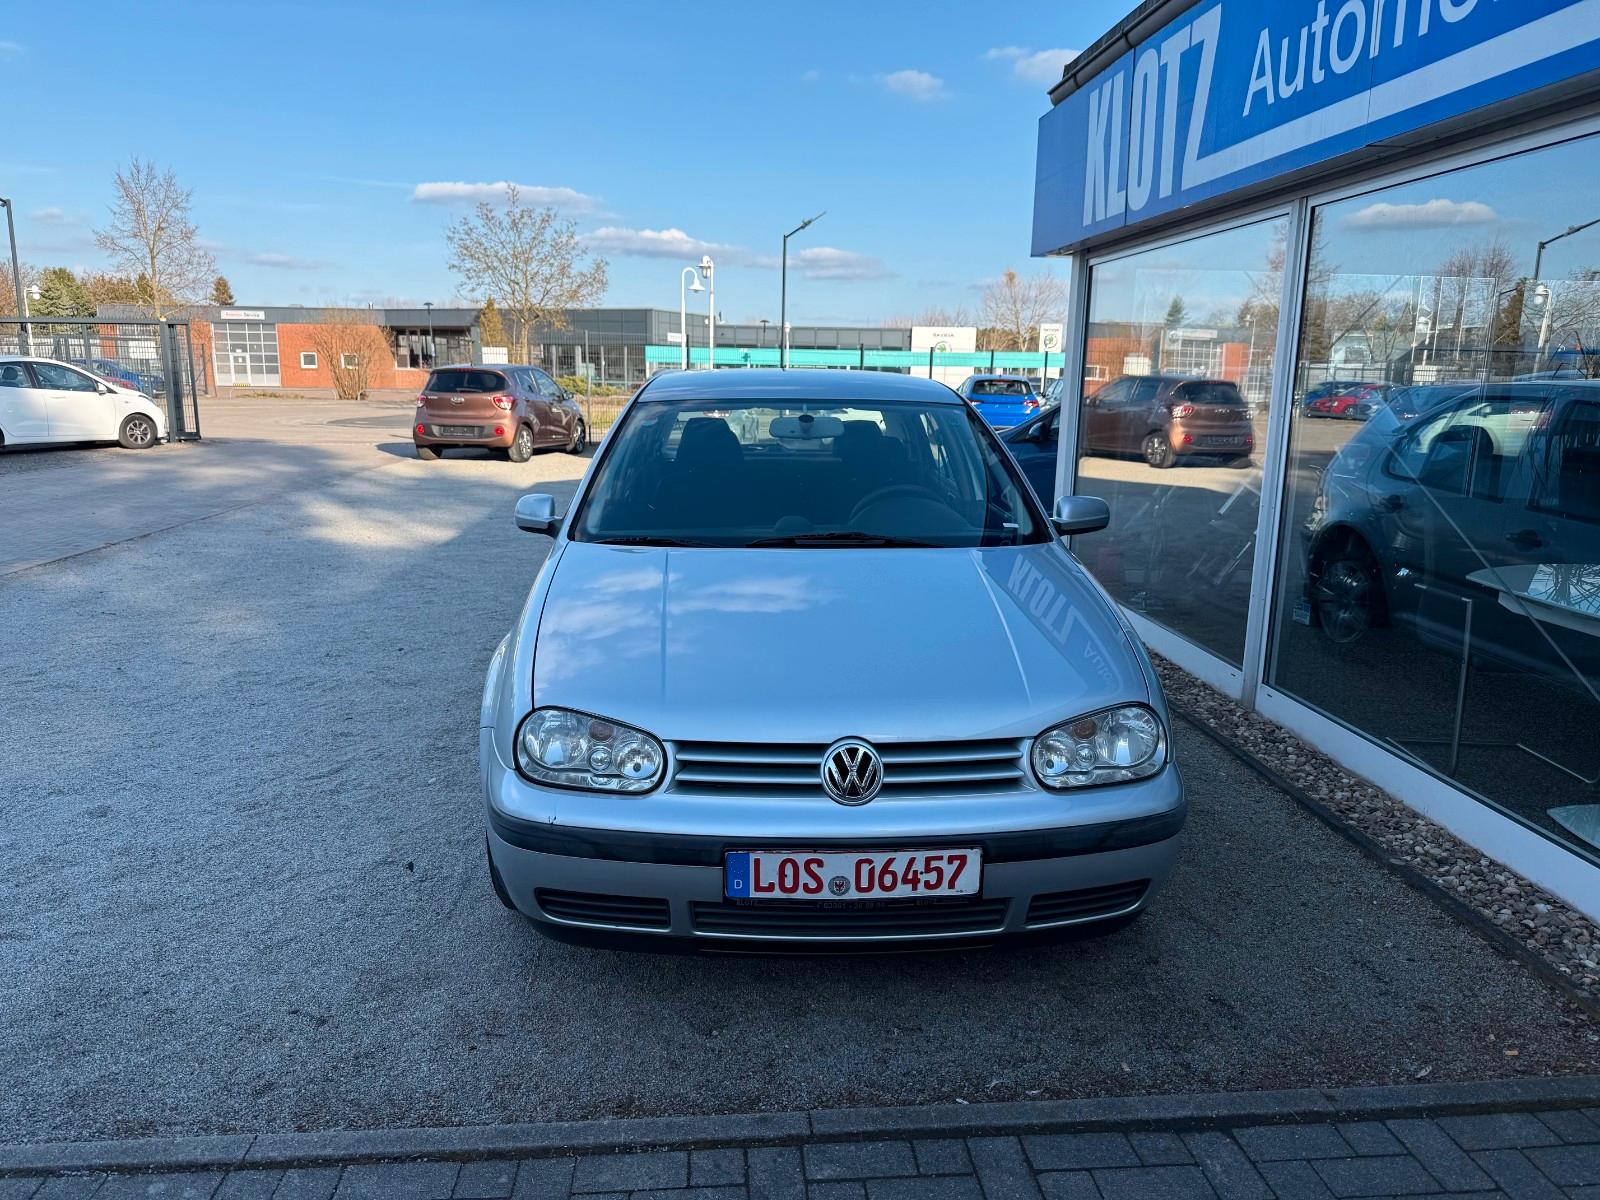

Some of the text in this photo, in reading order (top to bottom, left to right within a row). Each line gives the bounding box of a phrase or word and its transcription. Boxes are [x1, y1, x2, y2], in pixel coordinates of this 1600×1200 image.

[1083, 0, 1482, 227] KLOTZ Autom
[734, 854, 969, 894] D LOS 06457
